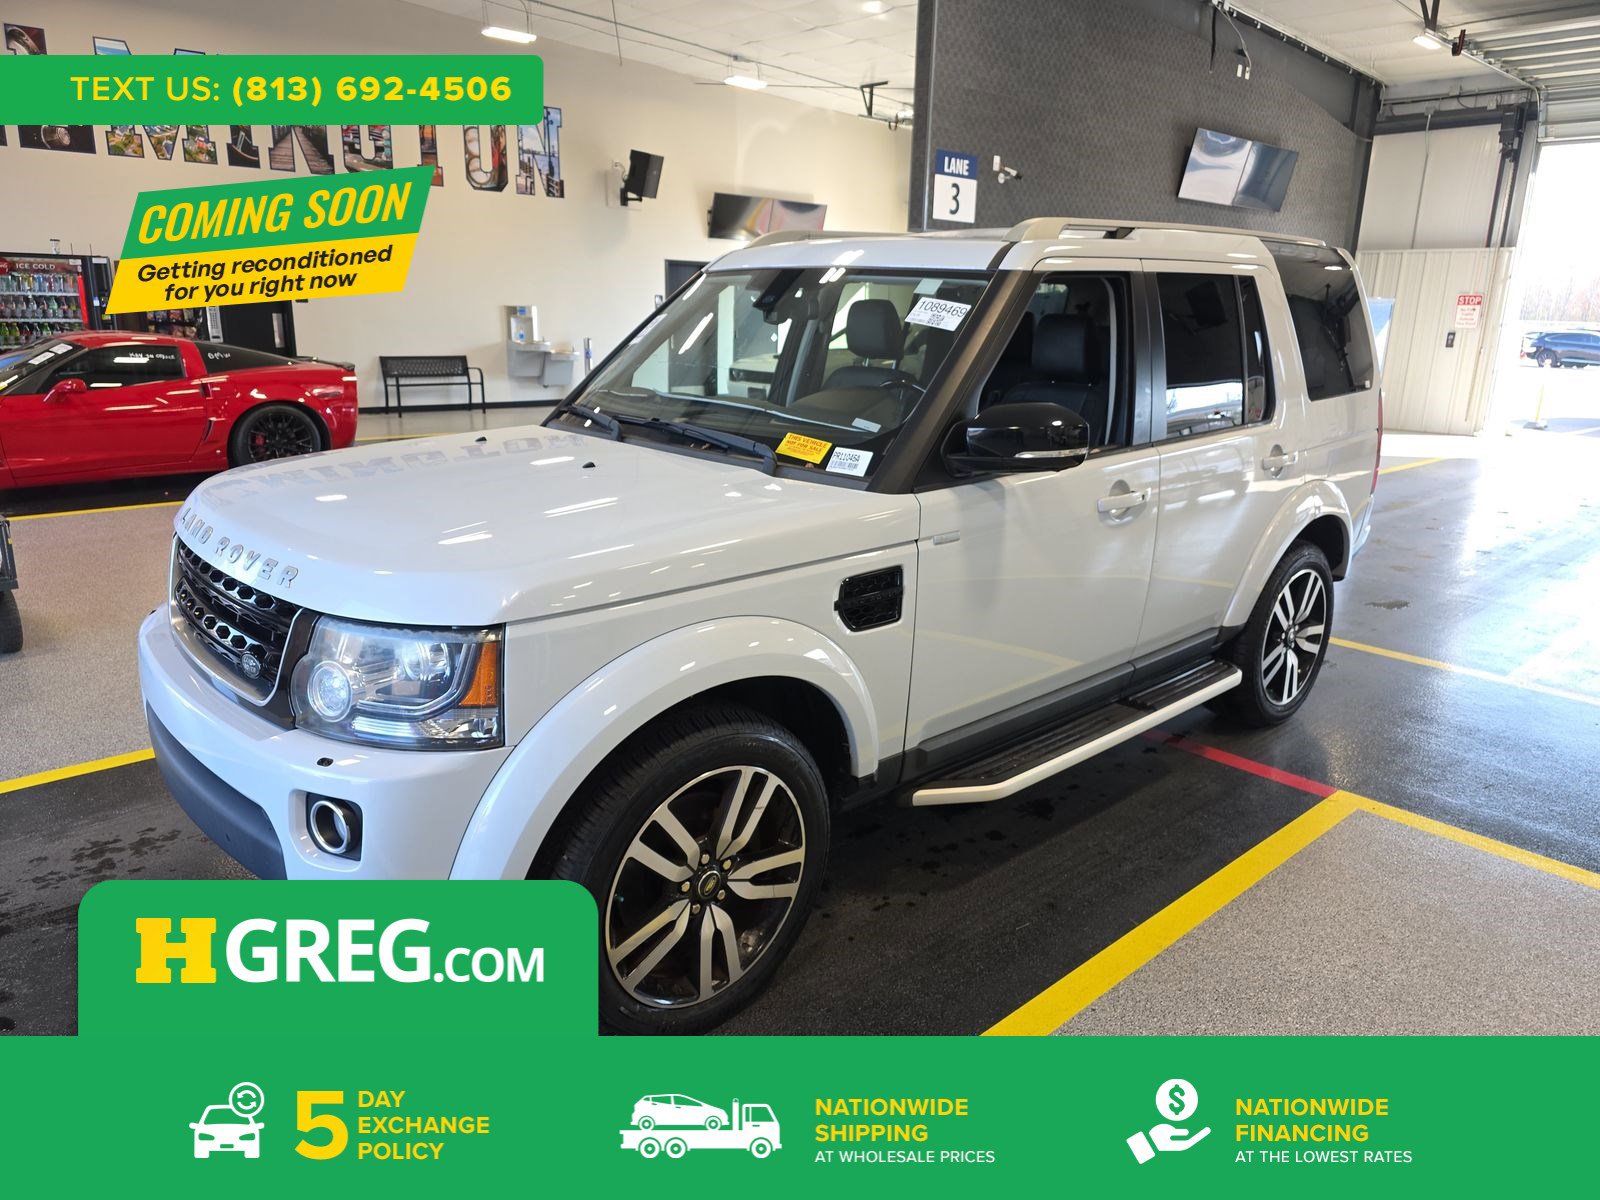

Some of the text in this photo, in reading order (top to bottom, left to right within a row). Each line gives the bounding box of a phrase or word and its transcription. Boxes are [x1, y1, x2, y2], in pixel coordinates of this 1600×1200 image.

[943, 156, 970, 176] LANE
[949, 182, 960, 215] 3
[919, 300, 968, 318] 1089469
[1459, 296, 1482, 305] STOP
[181, 507, 299, 589] LAND ROVER
